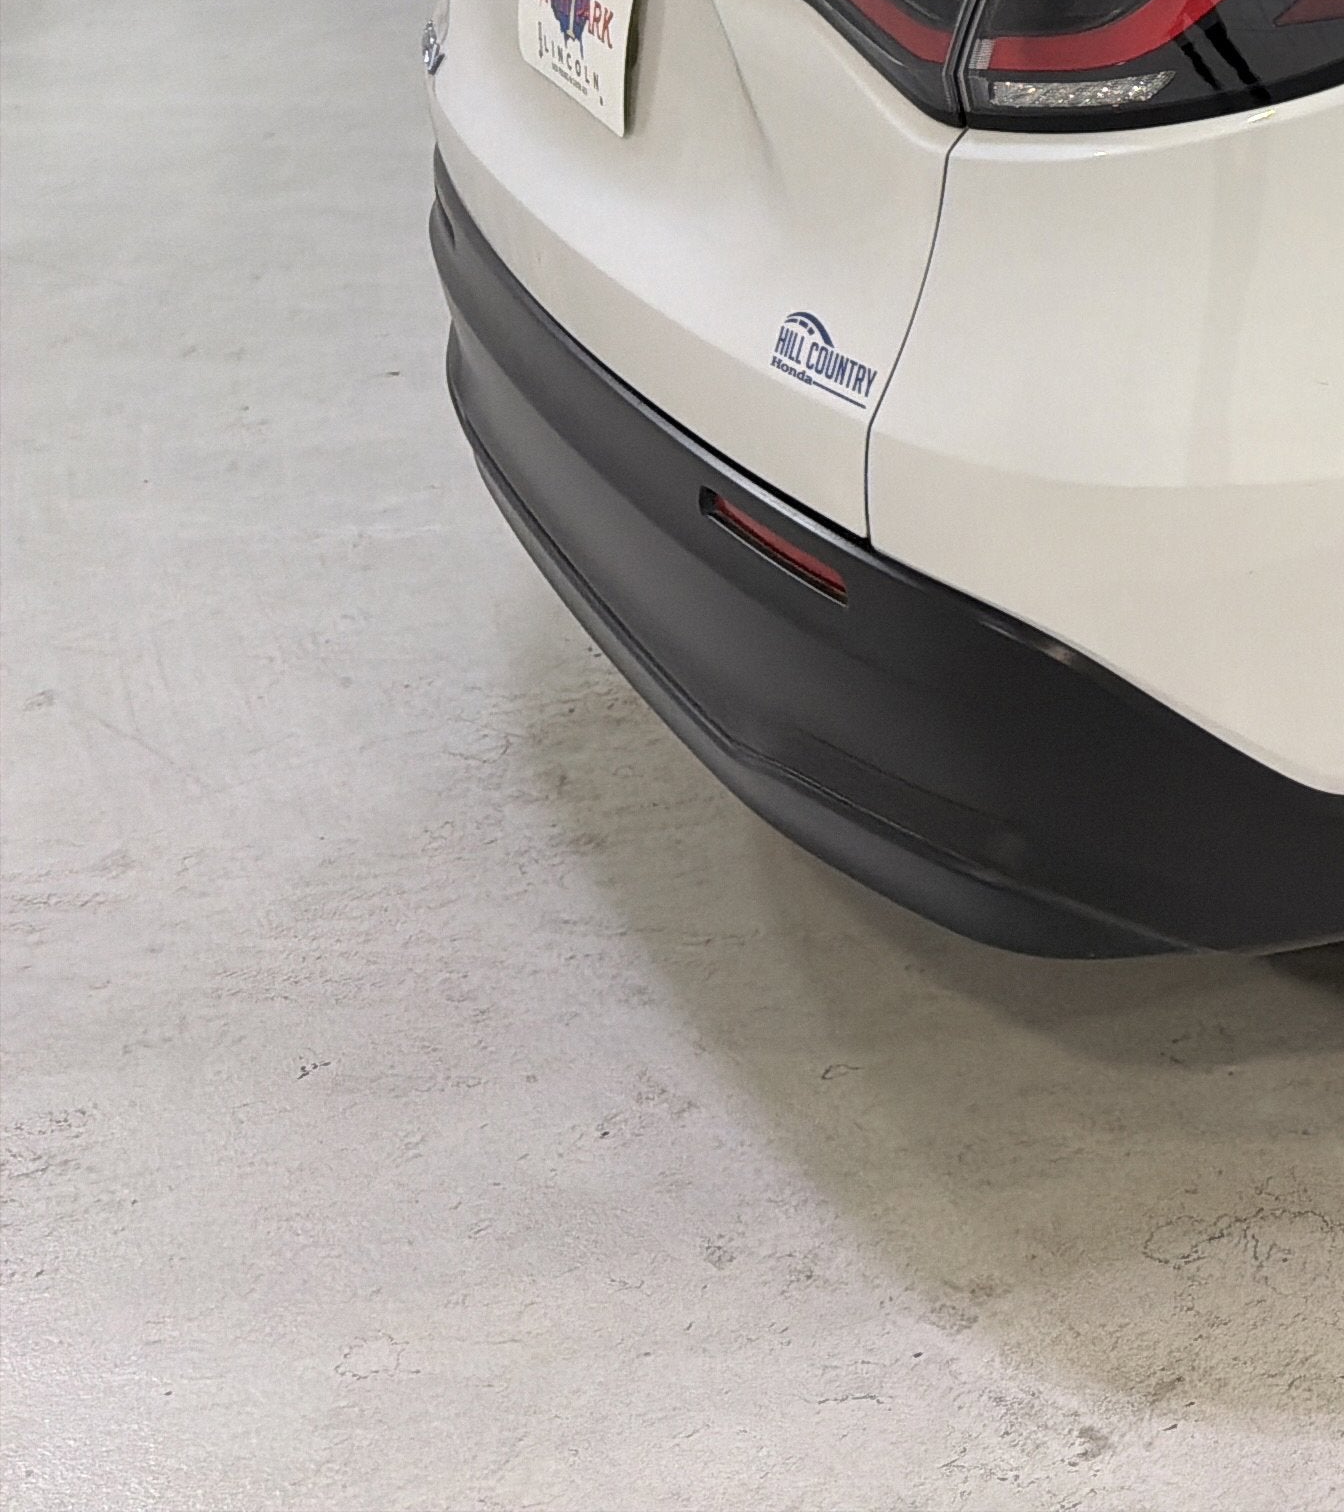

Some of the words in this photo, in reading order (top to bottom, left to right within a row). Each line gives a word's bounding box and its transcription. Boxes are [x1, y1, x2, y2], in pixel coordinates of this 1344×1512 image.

[543, 34, 600, 90] LINCOLN
[770, 356, 814, 385] Honda
[774, 325, 805, 365] HILL
[806, 341, 878, 398] COUNTRY
